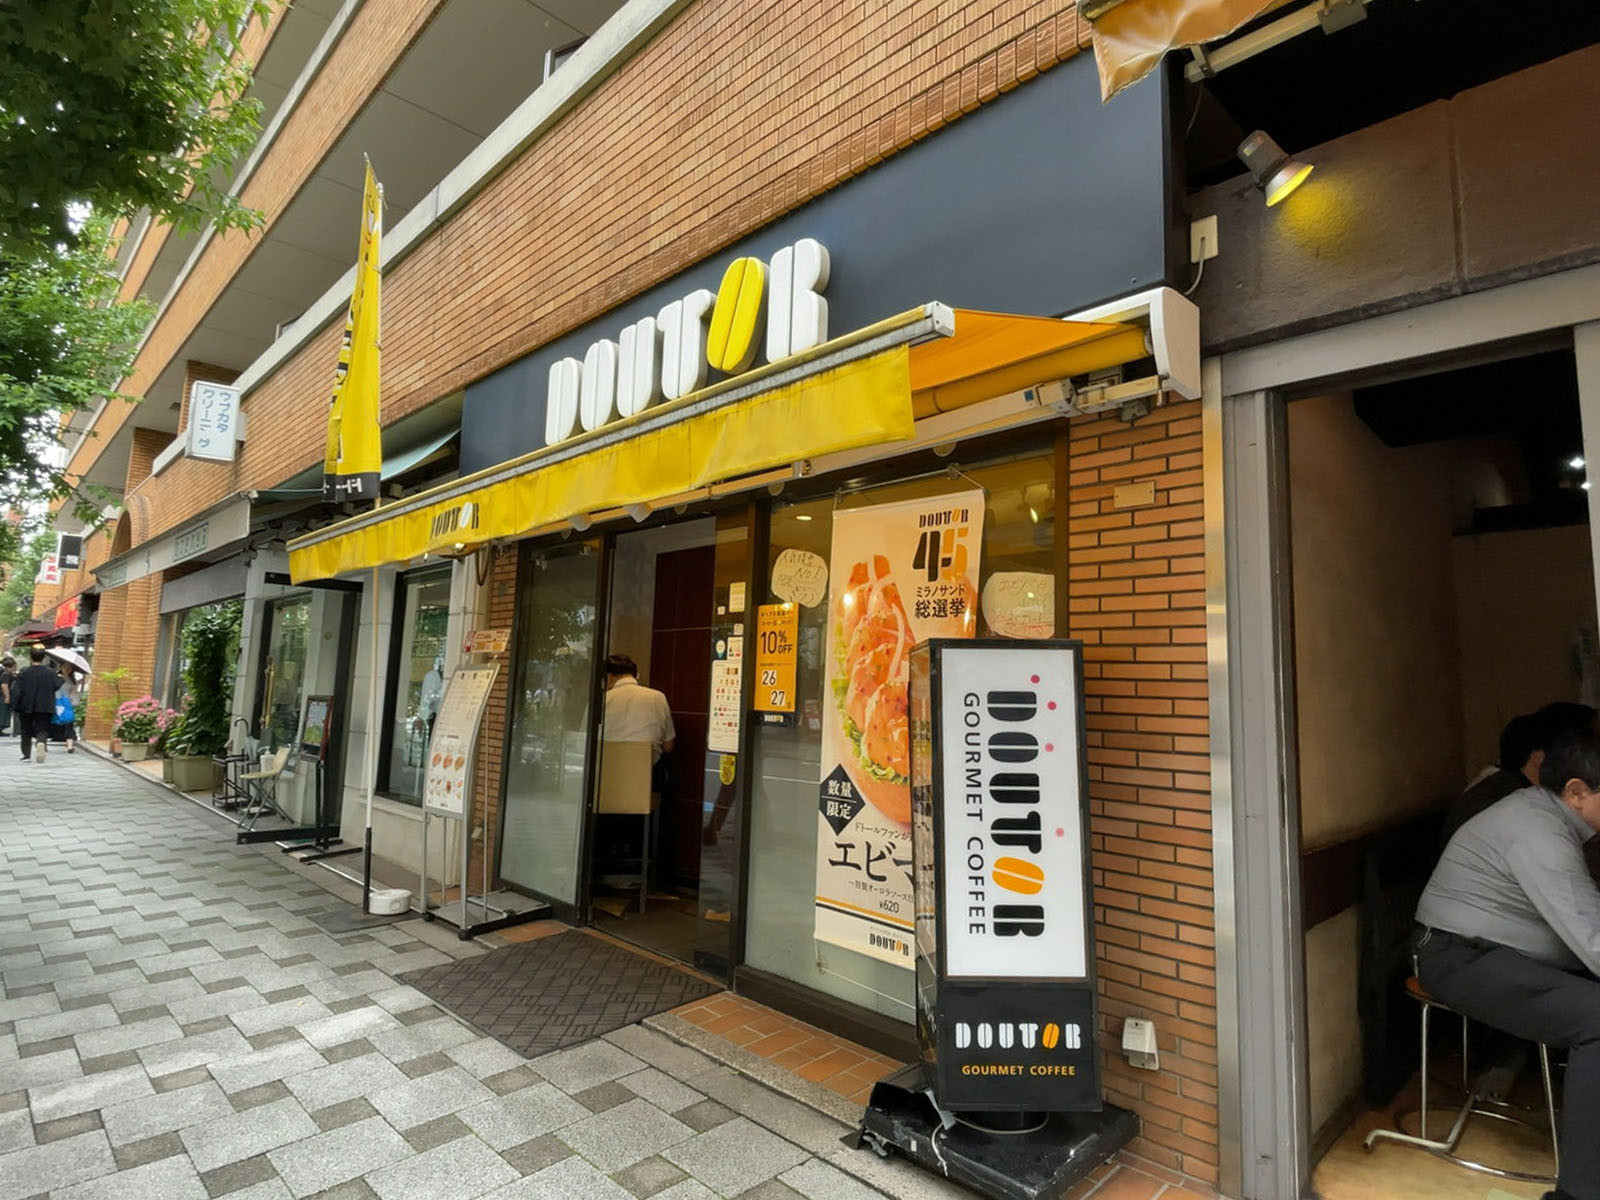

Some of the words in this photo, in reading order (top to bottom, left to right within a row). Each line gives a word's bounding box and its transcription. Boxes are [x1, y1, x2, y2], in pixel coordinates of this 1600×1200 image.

[545, 238, 830, 446] DOUTOR
[919, 508, 969, 528] DOUTOR
[912, 527, 969, 582] 45
[916, 583, 966, 598] ミラノサンド
[914, 597, 966, 619] 総選挙
[762, 670, 776, 686] 26
[771, 690, 785, 706] 27
[963, 692, 983, 822] GOURMET
[827, 780, 853, 798] 数量
[826, 800, 852, 820] 限定
[986, 690, 1045, 937] DOUTOR
[967, 836, 986, 935] COFFEE
[869, 932, 909, 957] DOUTOR
[955, 1022, 1081, 1050] DOUTOR
[961, 1065, 1024, 1076] GOURMET
[1029, 1065, 1076, 1076] COFFEE
